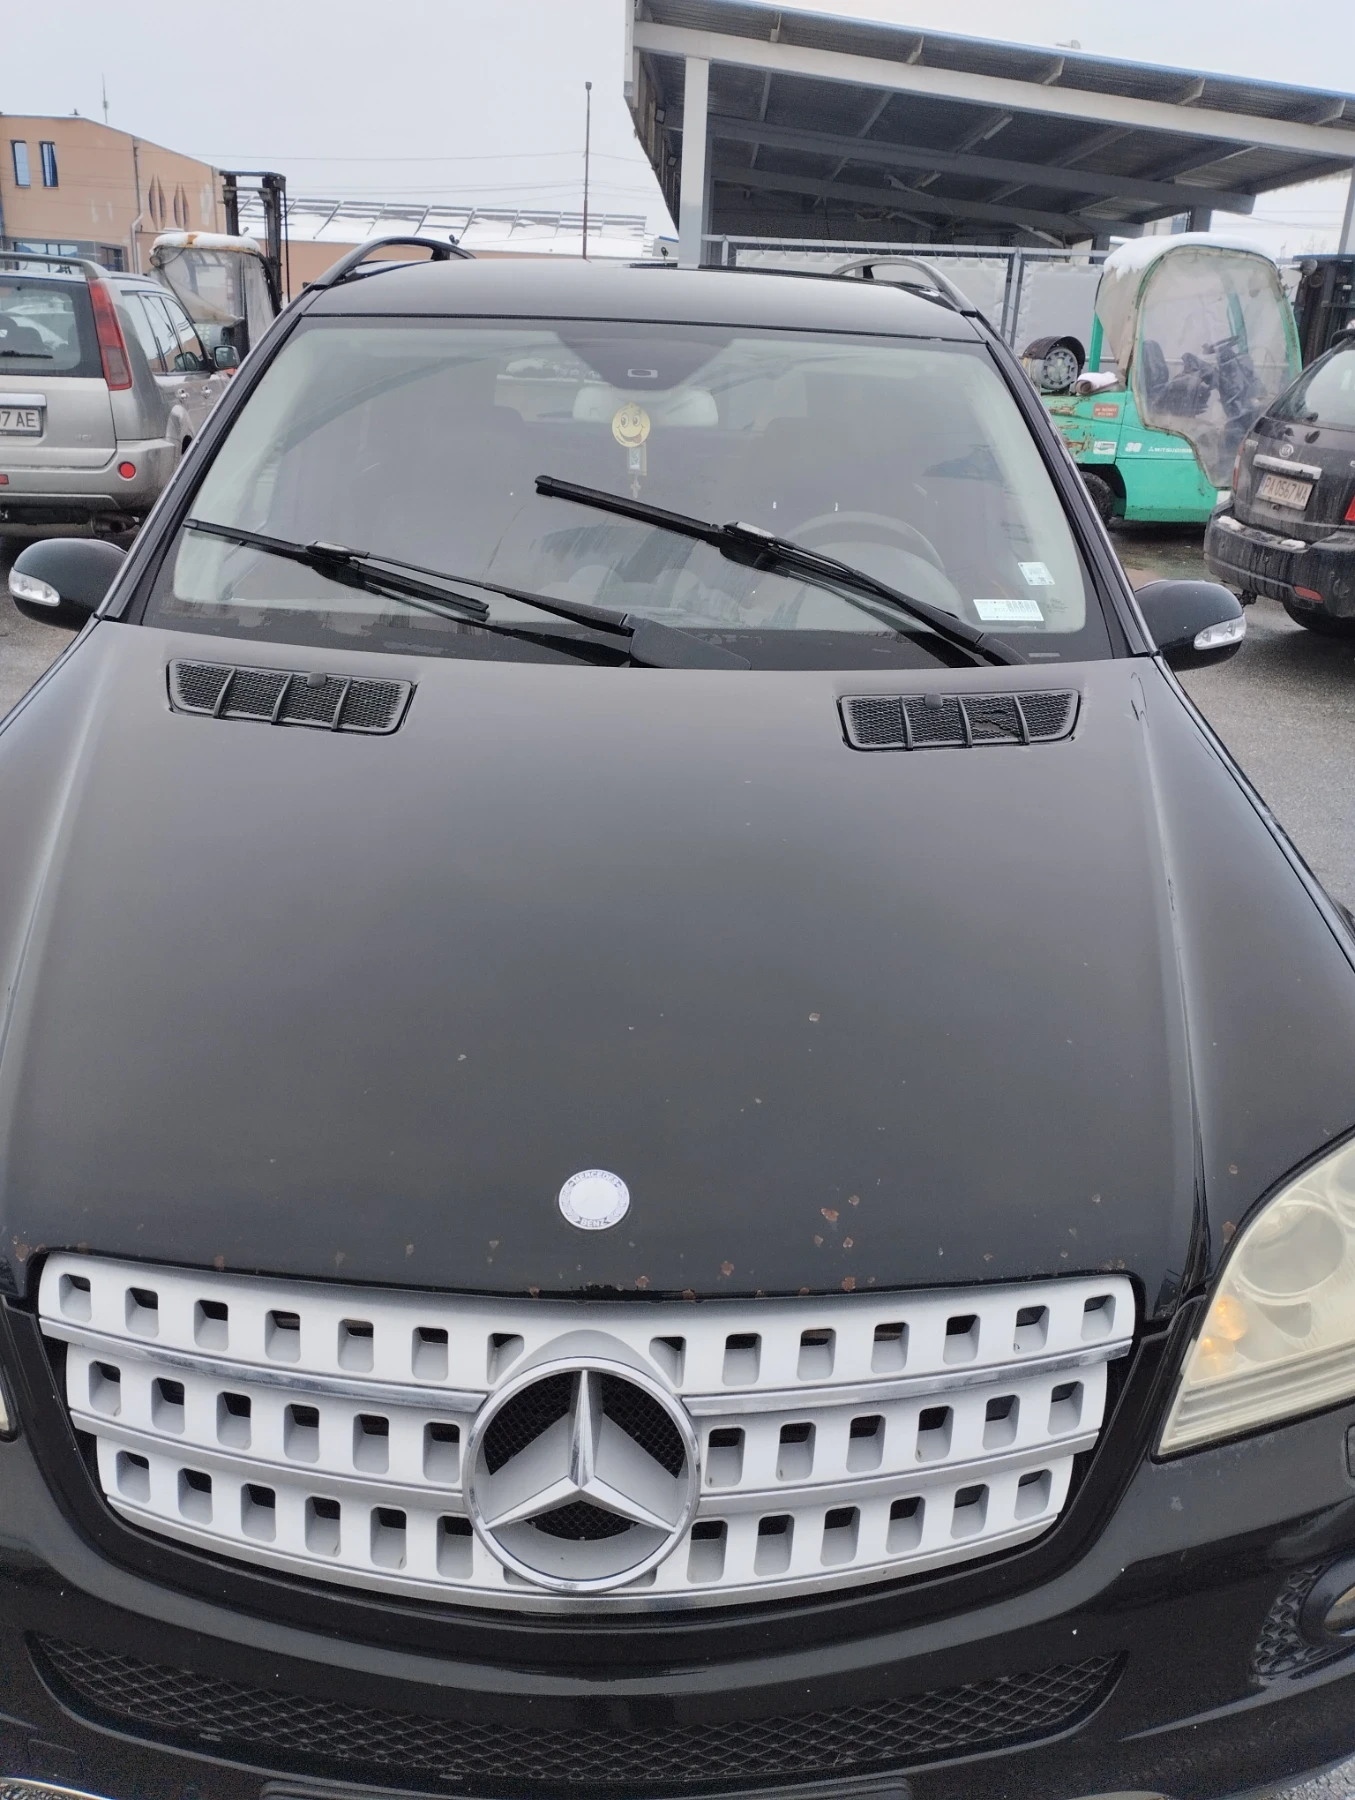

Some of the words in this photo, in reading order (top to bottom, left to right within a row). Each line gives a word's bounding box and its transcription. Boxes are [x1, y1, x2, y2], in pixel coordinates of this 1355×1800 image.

[16, 411, 36, 428] AE
[1263, 476, 1276, 496] PA
[1274, 480, 1298, 500] 0567
[573, 1171, 619, 1186] MERCEDES
[580, 1218, 605, 1227] BENZ
